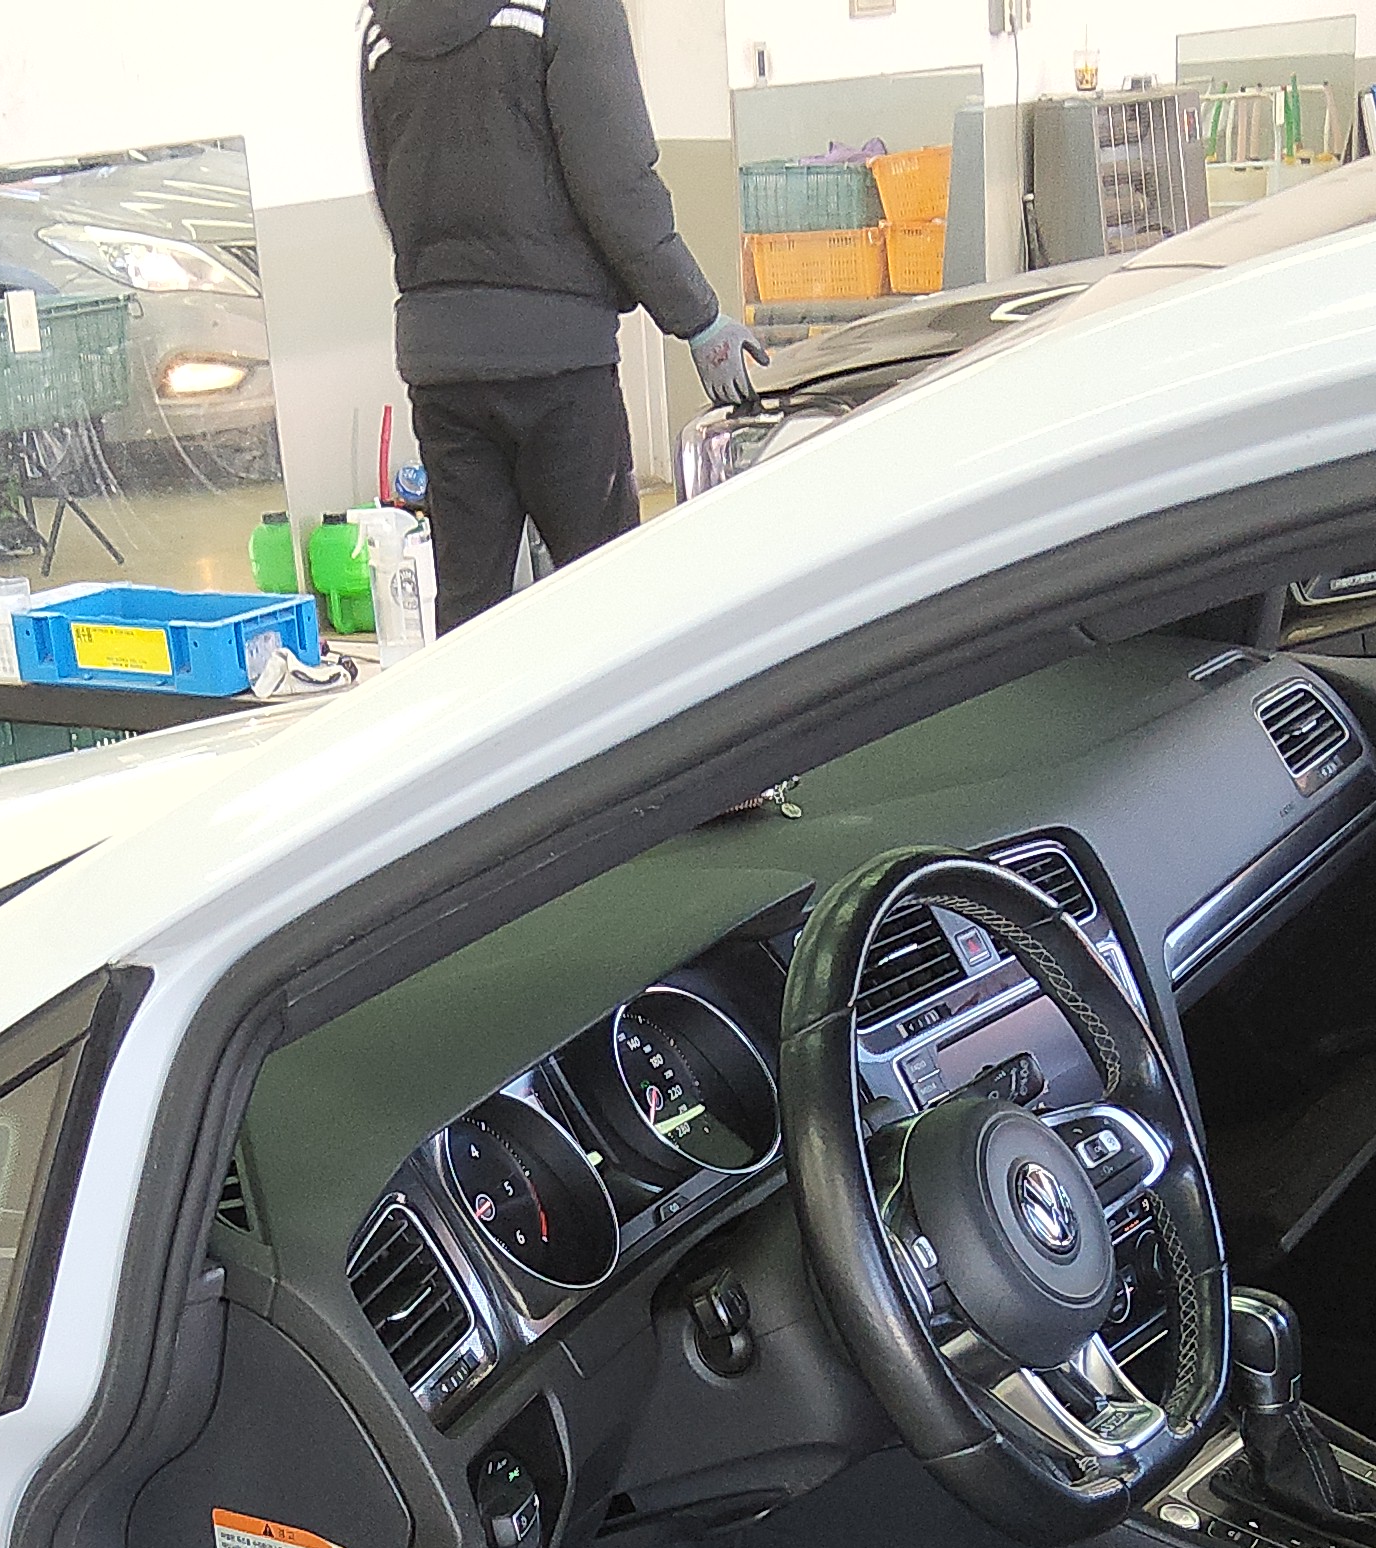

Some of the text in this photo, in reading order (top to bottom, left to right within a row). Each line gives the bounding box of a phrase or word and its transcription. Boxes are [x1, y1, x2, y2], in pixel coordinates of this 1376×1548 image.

[667, 1084, 683, 1101] 220
[470, 1144, 480, 1158] 4
[503, 1180, 514, 1197] 5
[516, 1229, 526, 1245] 6
